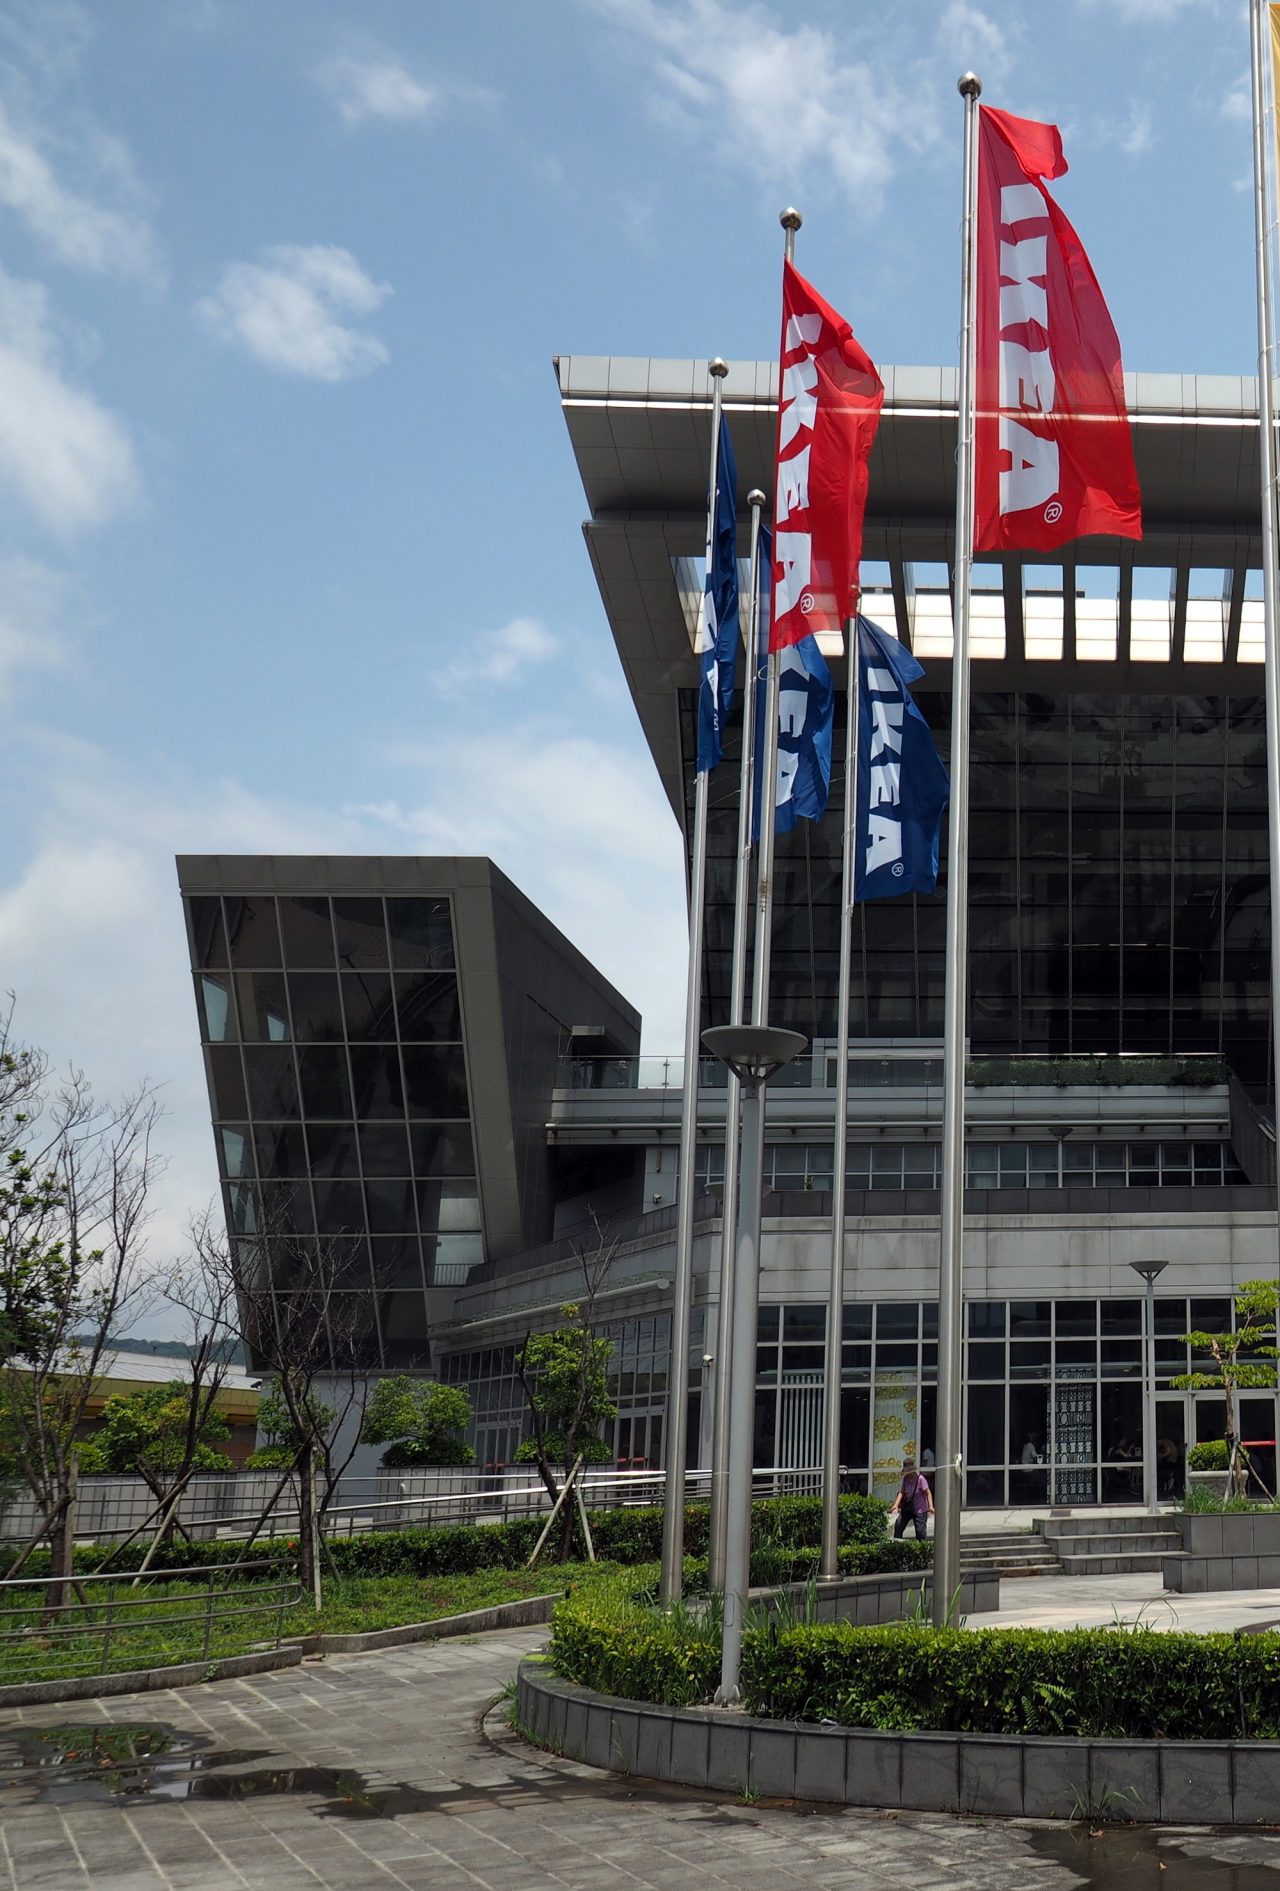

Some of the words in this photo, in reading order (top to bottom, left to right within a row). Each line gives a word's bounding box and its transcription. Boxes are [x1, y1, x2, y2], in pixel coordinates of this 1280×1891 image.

[775, 313, 824, 623] IKEA
[1000, 183, 1060, 516] IKEA
[865, 667, 904, 876] IKEA
